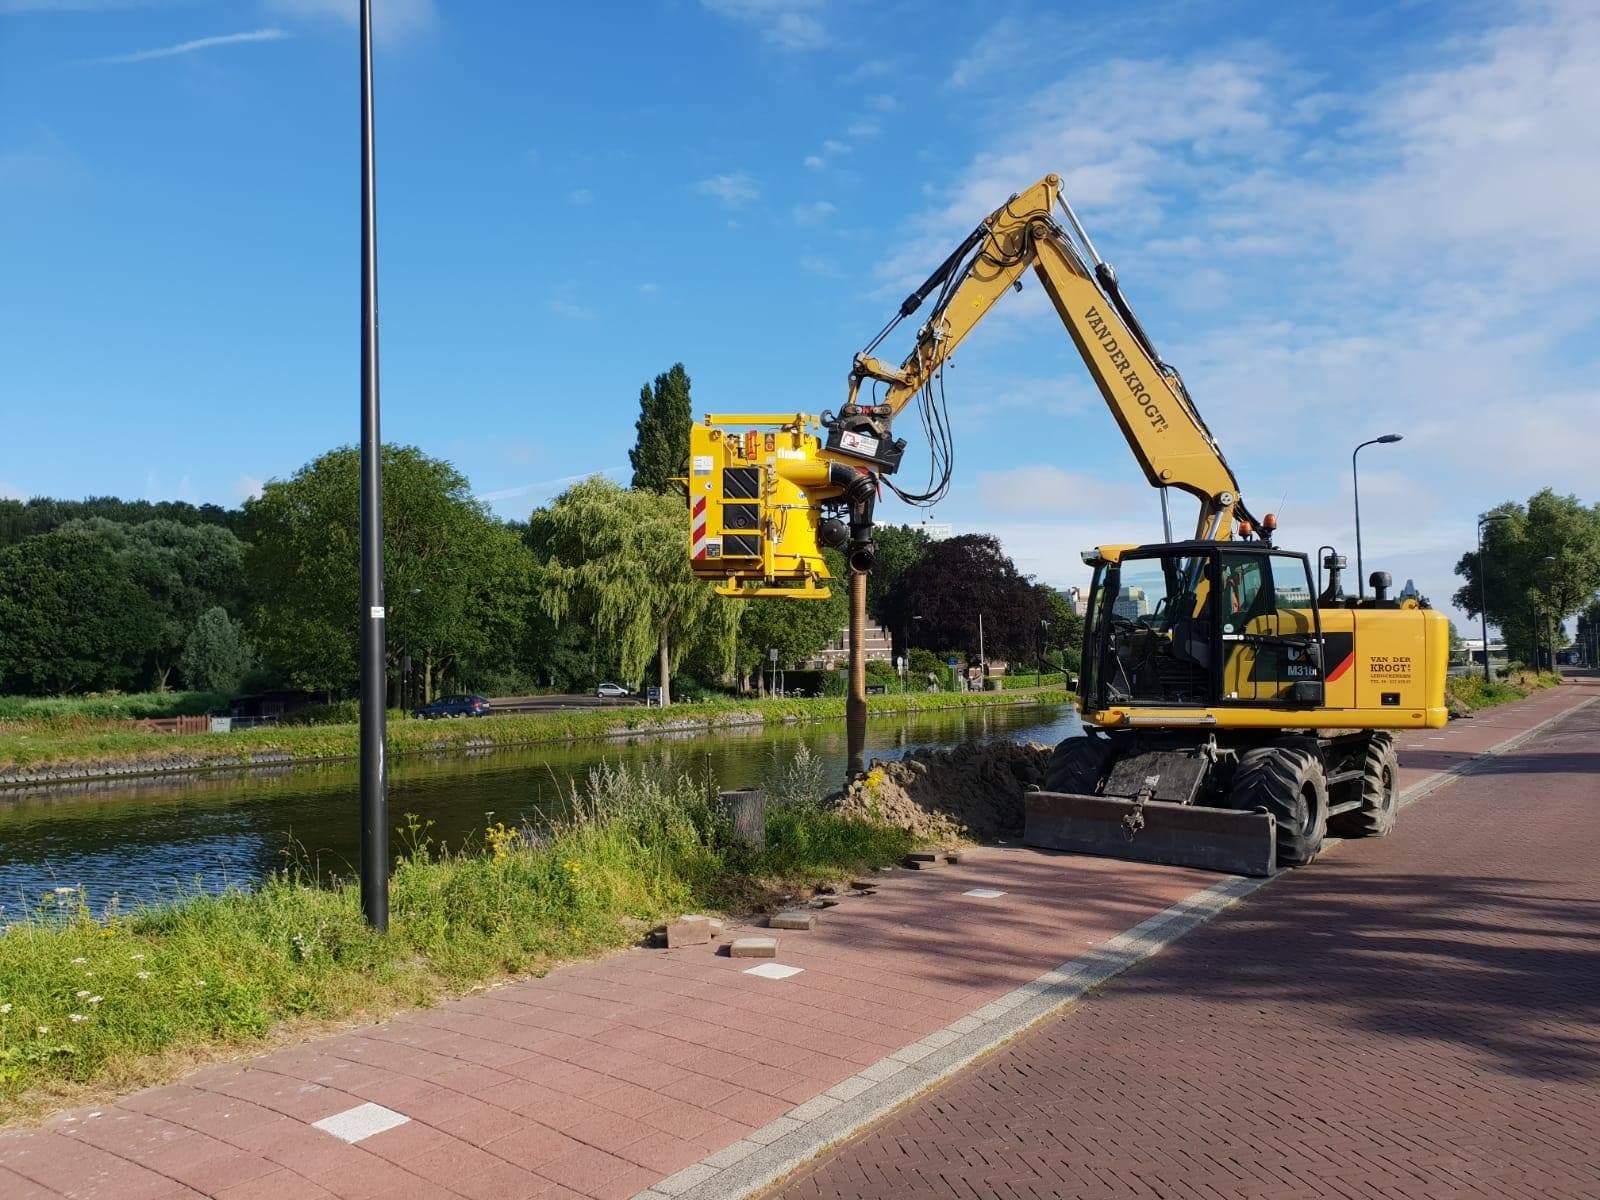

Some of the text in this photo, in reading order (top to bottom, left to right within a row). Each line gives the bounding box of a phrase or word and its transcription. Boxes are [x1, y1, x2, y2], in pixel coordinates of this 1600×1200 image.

[1084, 305, 1112, 341] VAN
[1102, 337, 1131, 374] DER
[1122, 370, 1166, 427] KROGT
[1287, 665, 1317, 676] M316
[1370, 664, 1407, 672] KROGT
